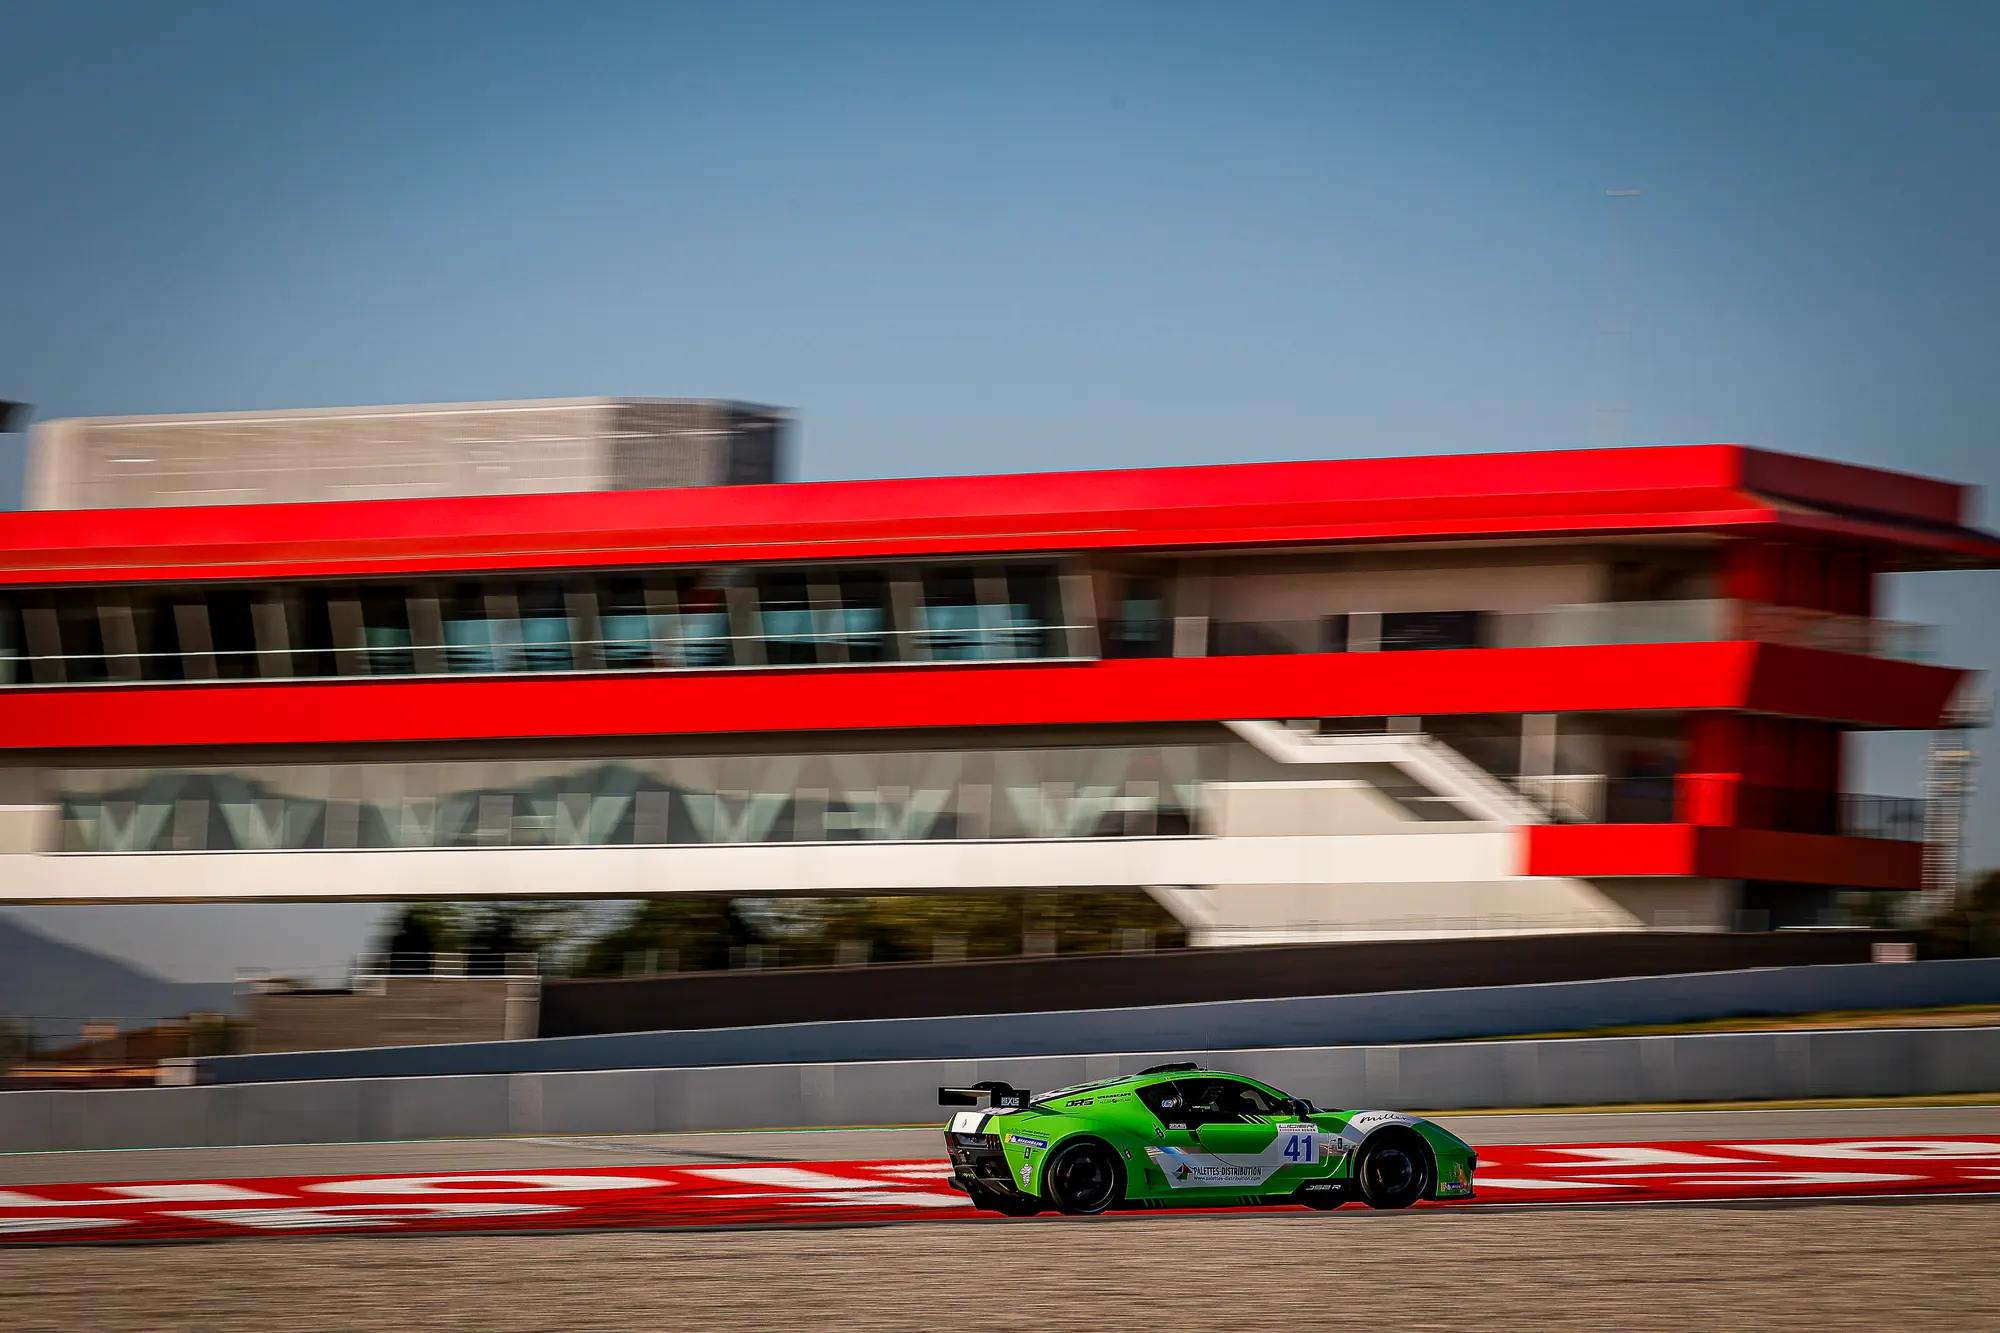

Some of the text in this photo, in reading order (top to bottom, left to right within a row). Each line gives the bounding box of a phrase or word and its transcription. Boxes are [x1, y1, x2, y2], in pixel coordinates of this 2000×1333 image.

[1001, 1097, 1019, 1106] HEXIS
[1065, 1097, 1094, 1107] DRS
[1017, 1138, 1044, 1147] MICHELIN
[1283, 1134, 1312, 1162] 41
[1193, 1166, 1262, 1176] PALETTES-DISTRIBUTION
